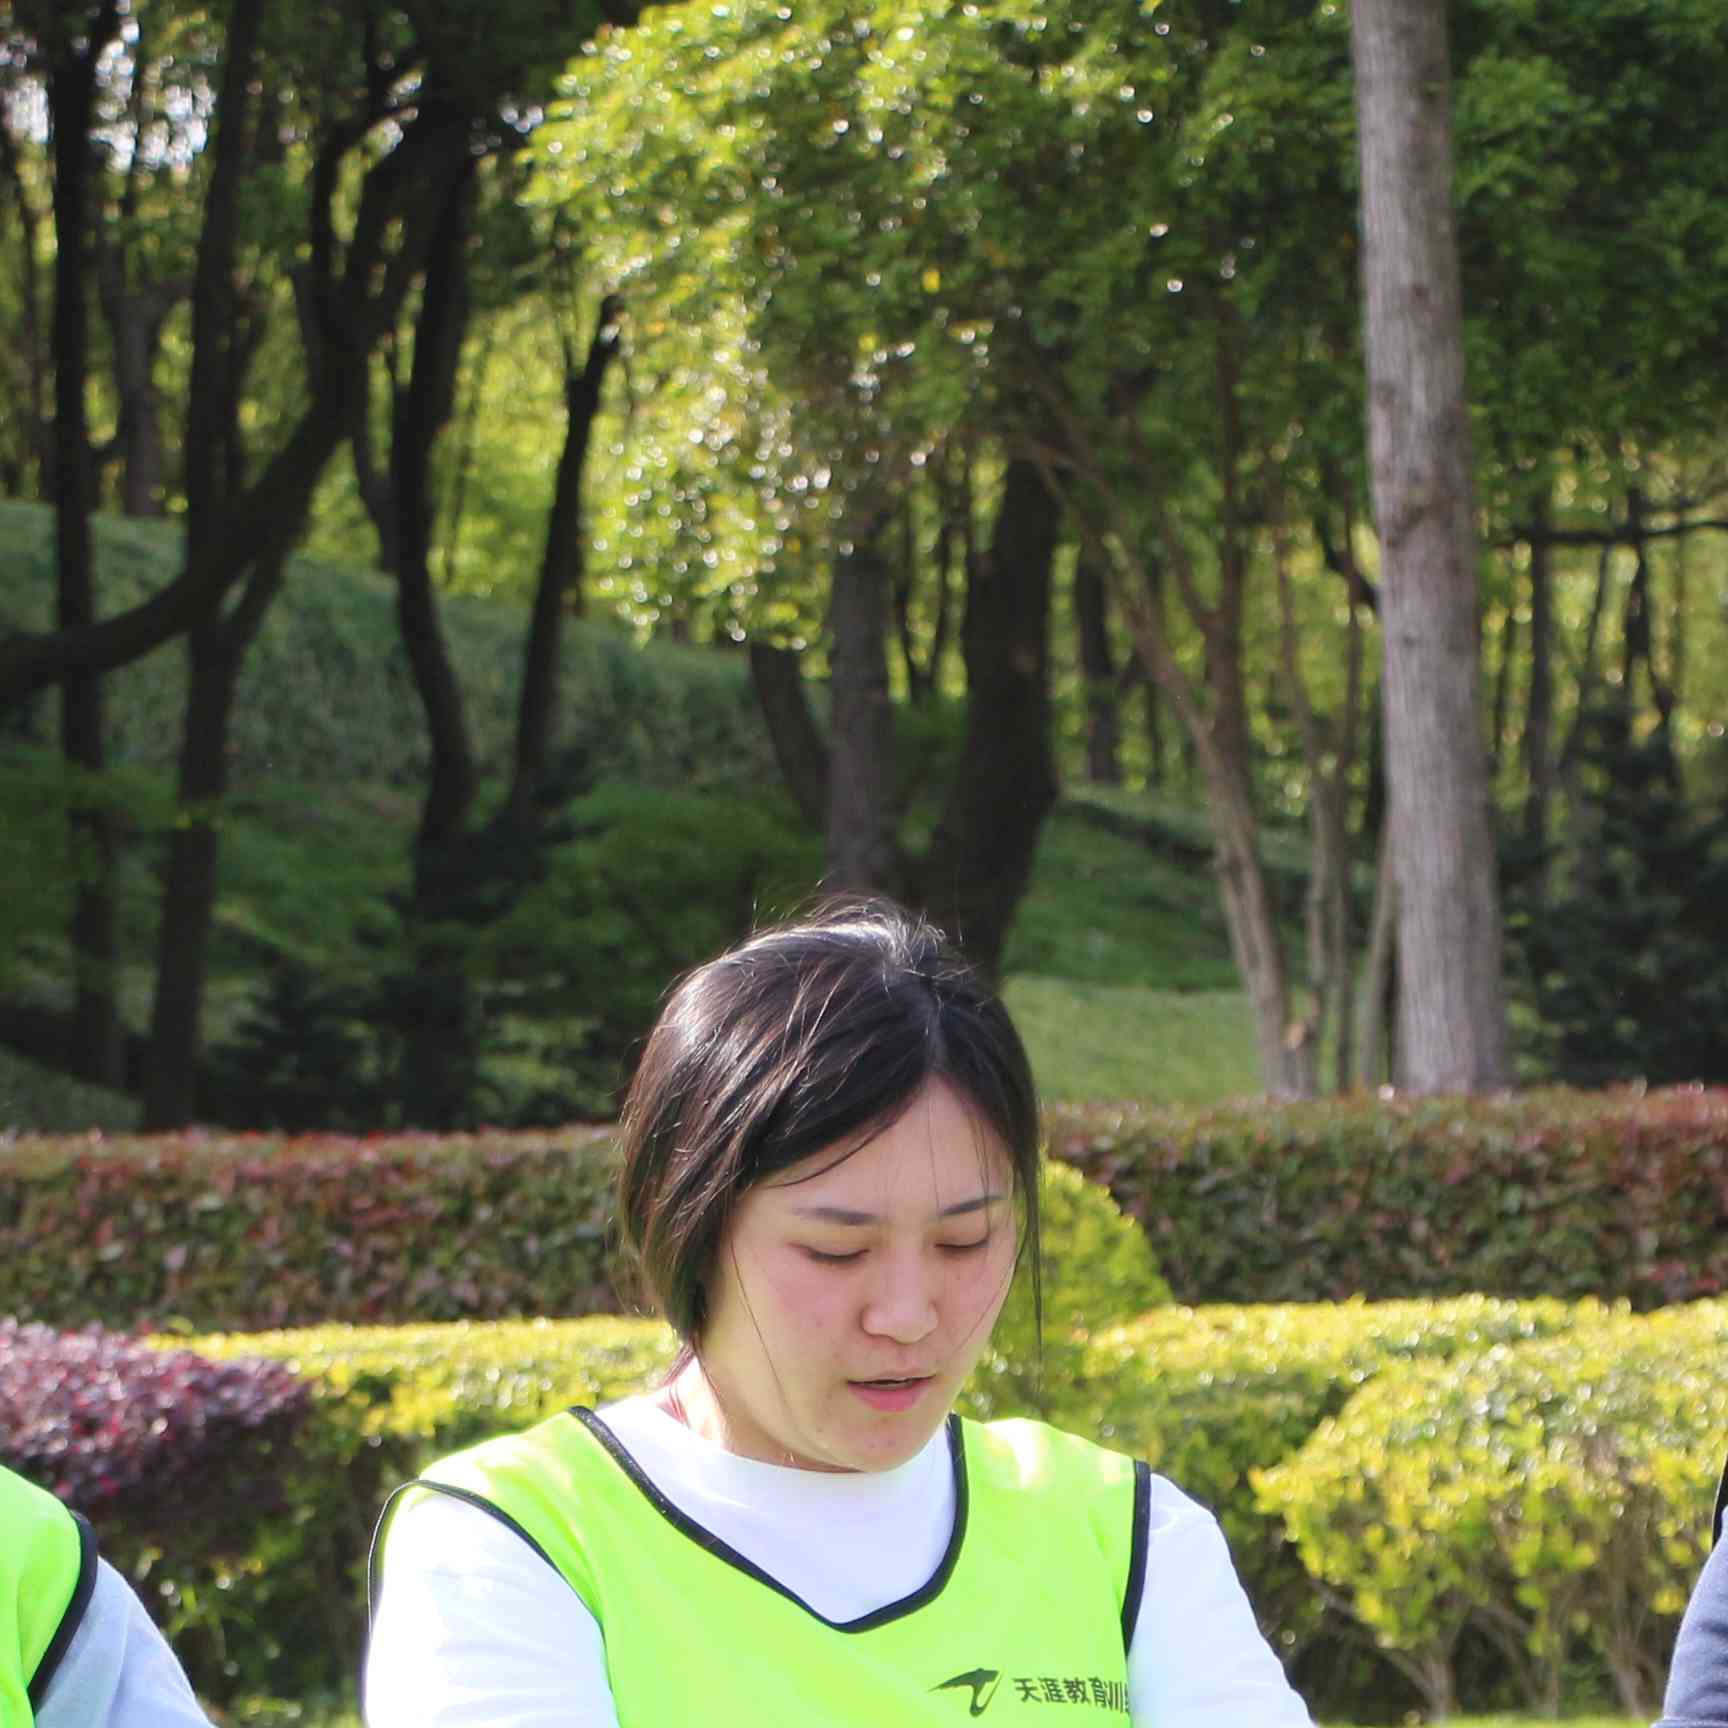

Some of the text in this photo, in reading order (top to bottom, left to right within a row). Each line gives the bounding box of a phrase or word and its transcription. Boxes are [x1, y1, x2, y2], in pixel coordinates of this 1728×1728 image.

[1011, 1676, 1129, 1714] 天涯教育训
